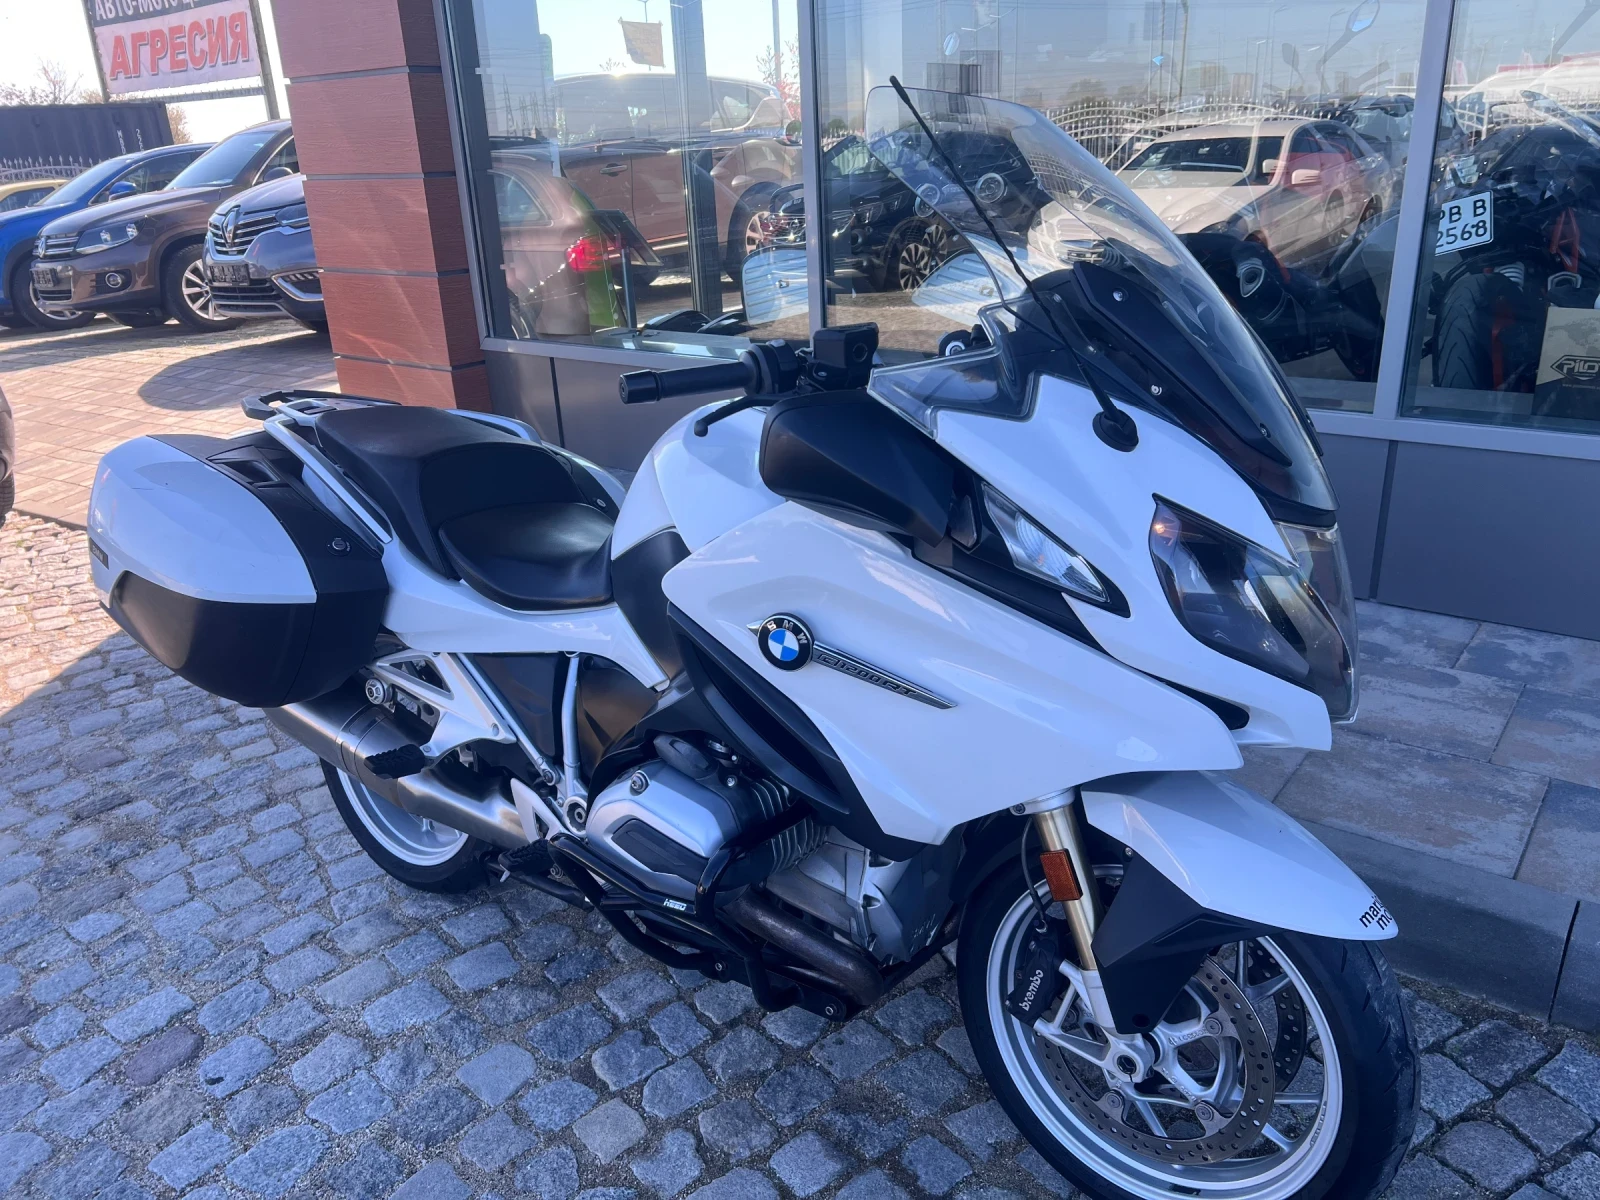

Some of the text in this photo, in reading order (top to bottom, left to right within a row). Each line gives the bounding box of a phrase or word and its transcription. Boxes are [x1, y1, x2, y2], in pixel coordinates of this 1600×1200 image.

[109, 11, 249, 80] АГРЕСИЯ
[1473, 199, 1486, 217] B
[1436, 220, 1488, 248] 2568
[766, 620, 808, 644] BMW
[1019, 969, 1044, 1012] brembo
